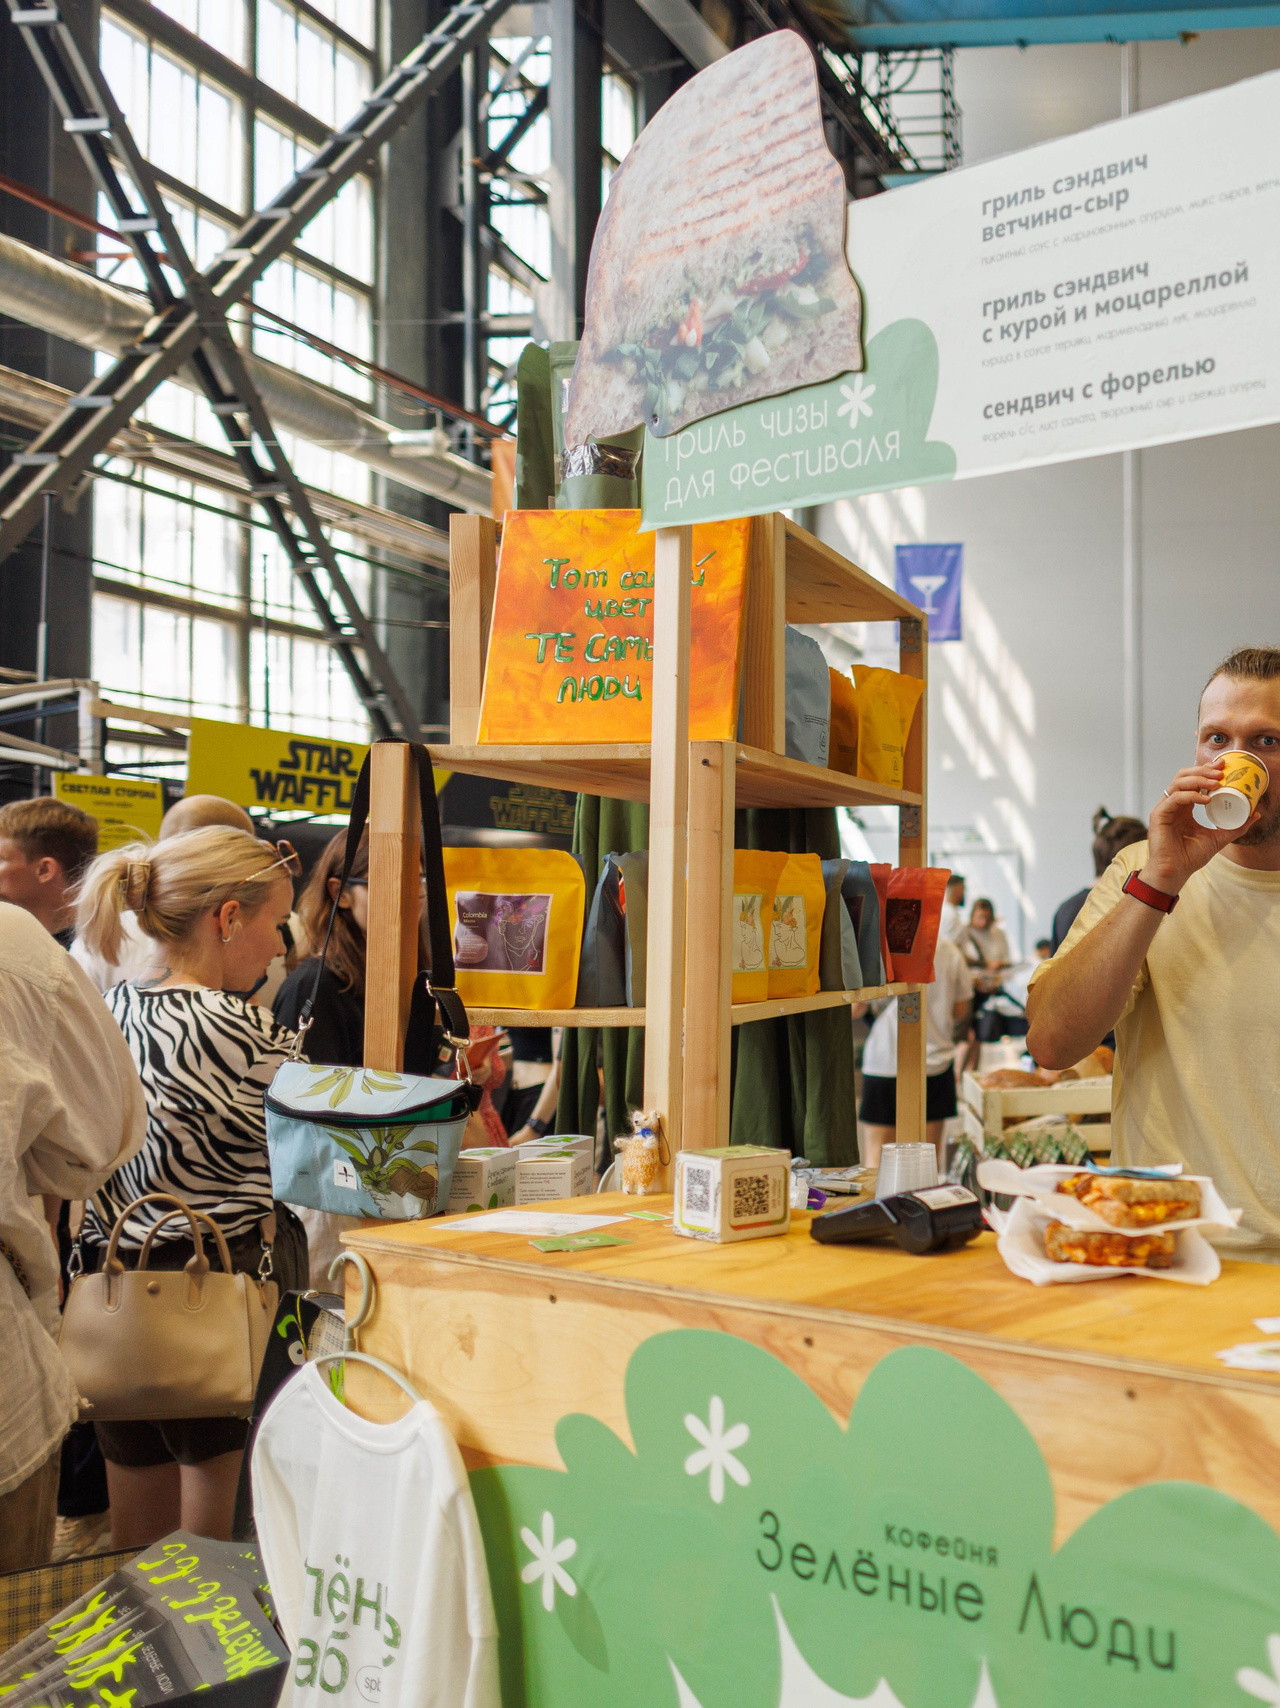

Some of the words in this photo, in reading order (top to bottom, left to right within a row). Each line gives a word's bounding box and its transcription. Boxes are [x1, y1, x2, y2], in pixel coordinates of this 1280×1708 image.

[981, 183, 1046, 218] гриль
[1052, 153, 1149, 194] сэндвич
[981, 187, 1130, 242] ветчина-сыр
[981, 290, 1047, 320] гриль
[1053, 261, 1150, 300] сэндвич
[981, 326, 994, 344] с
[999, 305, 1067, 343] курой
[1073, 304, 1088, 323] и
[1094, 260, 1250, 317] моцареллой
[981, 385, 1075, 420] сендвич
[1081, 382, 1094, 399] с
[1100, 356, 1217, 400] форелью
[760, 399, 829, 439] чизы
[664, 469, 716, 512] для
[729, 430, 901, 492] фестиваля
[620, 550, 717, 591] сай
[525, 632, 577, 664] ТЕ
[584, 632, 655, 664] САМ
[278, 740, 359, 778] STAR
[60, 782, 112, 797] СВЕТЛАЯ
[114, 786, 157, 800] СТОРОНА
[884, 1522, 999, 1568] кофейня
[756, 1509, 985, 1624] Зелёные
[1018, 1570, 1177, 1674] Люди
